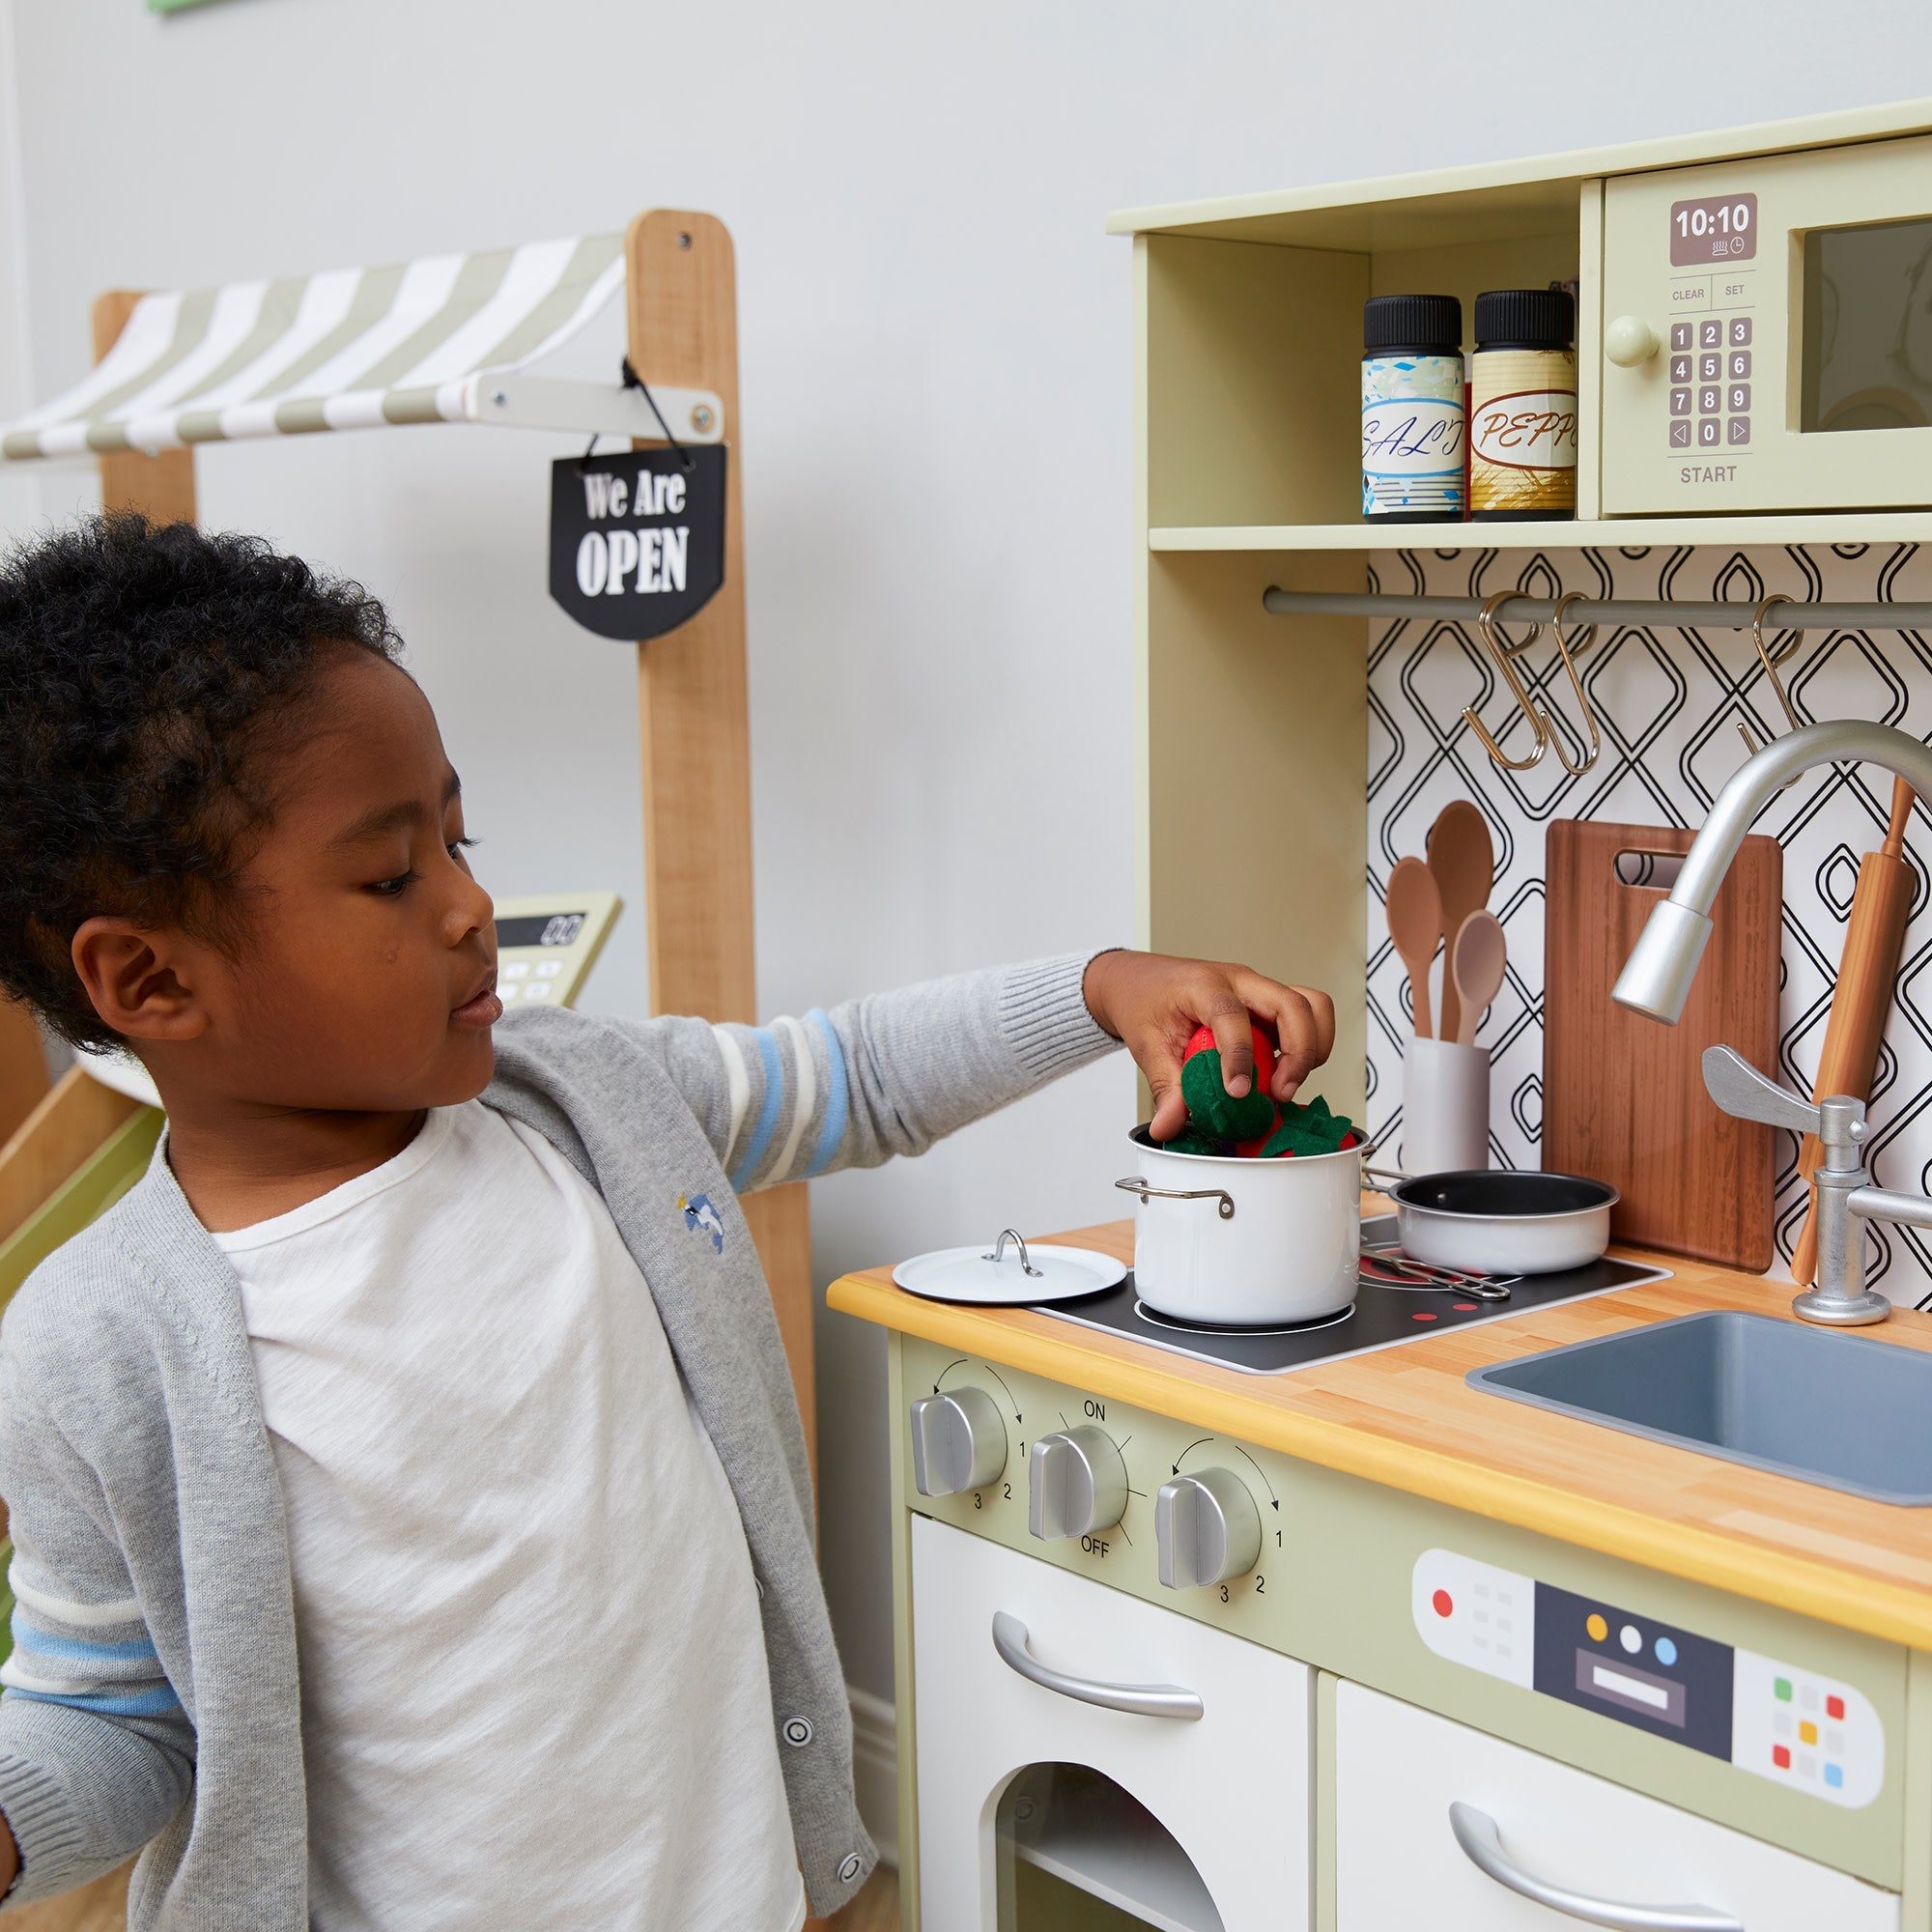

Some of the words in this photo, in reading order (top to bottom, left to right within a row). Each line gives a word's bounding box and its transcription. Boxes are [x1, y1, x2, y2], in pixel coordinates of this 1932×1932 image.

[1676, 204, 1749, 238] 10:10
[1672, 288, 1705, 300] CLEAR
[1724, 284, 1745, 296] SET
[1677, 328, 1685, 346] 1
[1705, 327, 1716, 343] 2
[1734, 324, 1746, 341] 3
[1676, 361, 1687, 378] 4
[1705, 358, 1716, 376] 5
[1734, 356, 1745, 374] 6
[1675, 393, 1686, 410] 7
[1704, 391, 1715, 409] 8
[1733, 389, 1745, 407] 9
[1704, 424, 1715, 441] 0
[1681, 466, 1738, 483] START
[583, 472, 628, 520] We
[633, 469, 687, 516] Are
[576, 526, 690, 597] OPEN
[1084, 1400, 1105, 1422] ON
[1019, 1441, 1025, 1458] 1
[974, 1492, 982, 1509] 3
[1004, 1483, 1011, 1500] 2
[1081, 1534, 1110, 1558] OFF
[1275, 1530, 1282, 1548] 1
[1256, 1576, 1265, 1594] 2
[1220, 1585, 1230, 1604] 3
